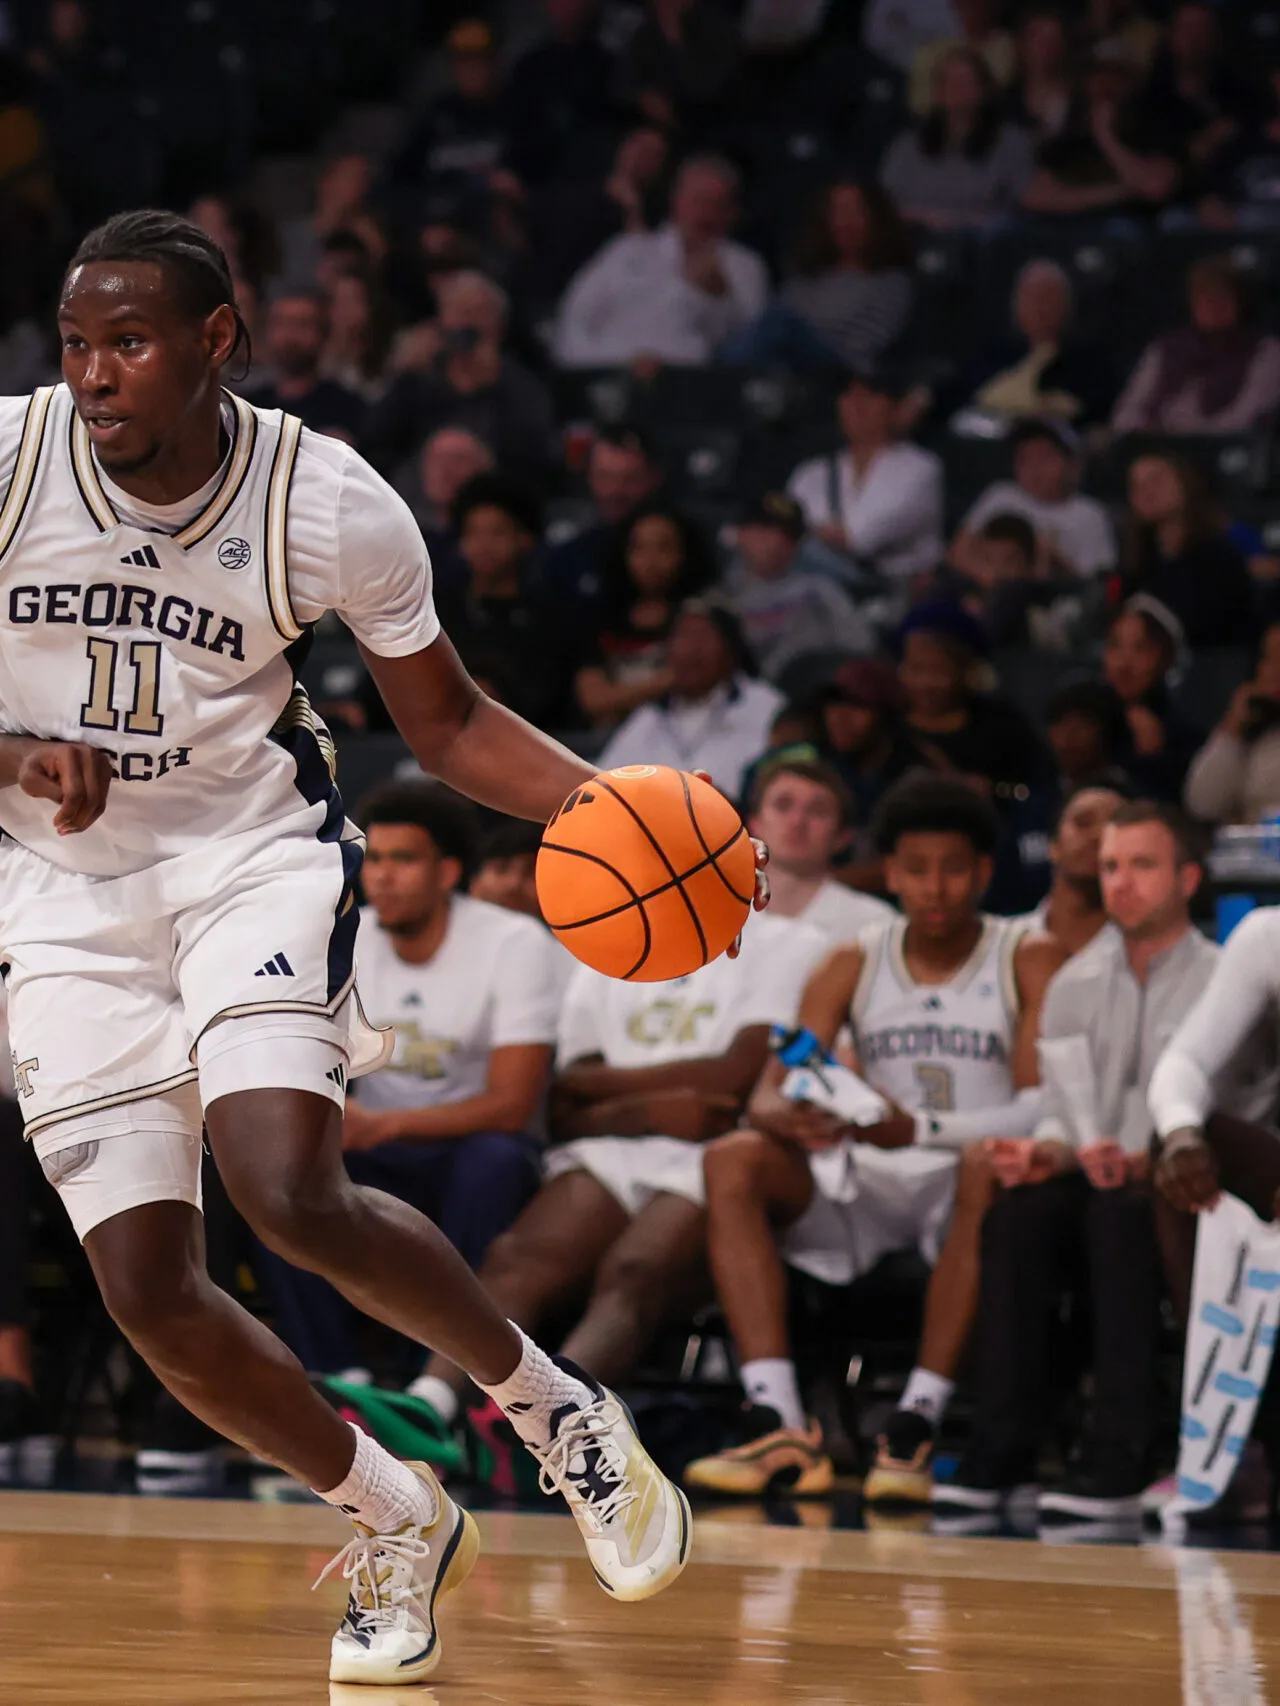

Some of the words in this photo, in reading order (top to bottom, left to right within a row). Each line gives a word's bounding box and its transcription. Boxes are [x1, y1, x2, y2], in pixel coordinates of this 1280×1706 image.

[9, 583, 245, 661] GEORGIA
[80, 636, 164, 736] 11
[98, 747, 193, 781] CH
